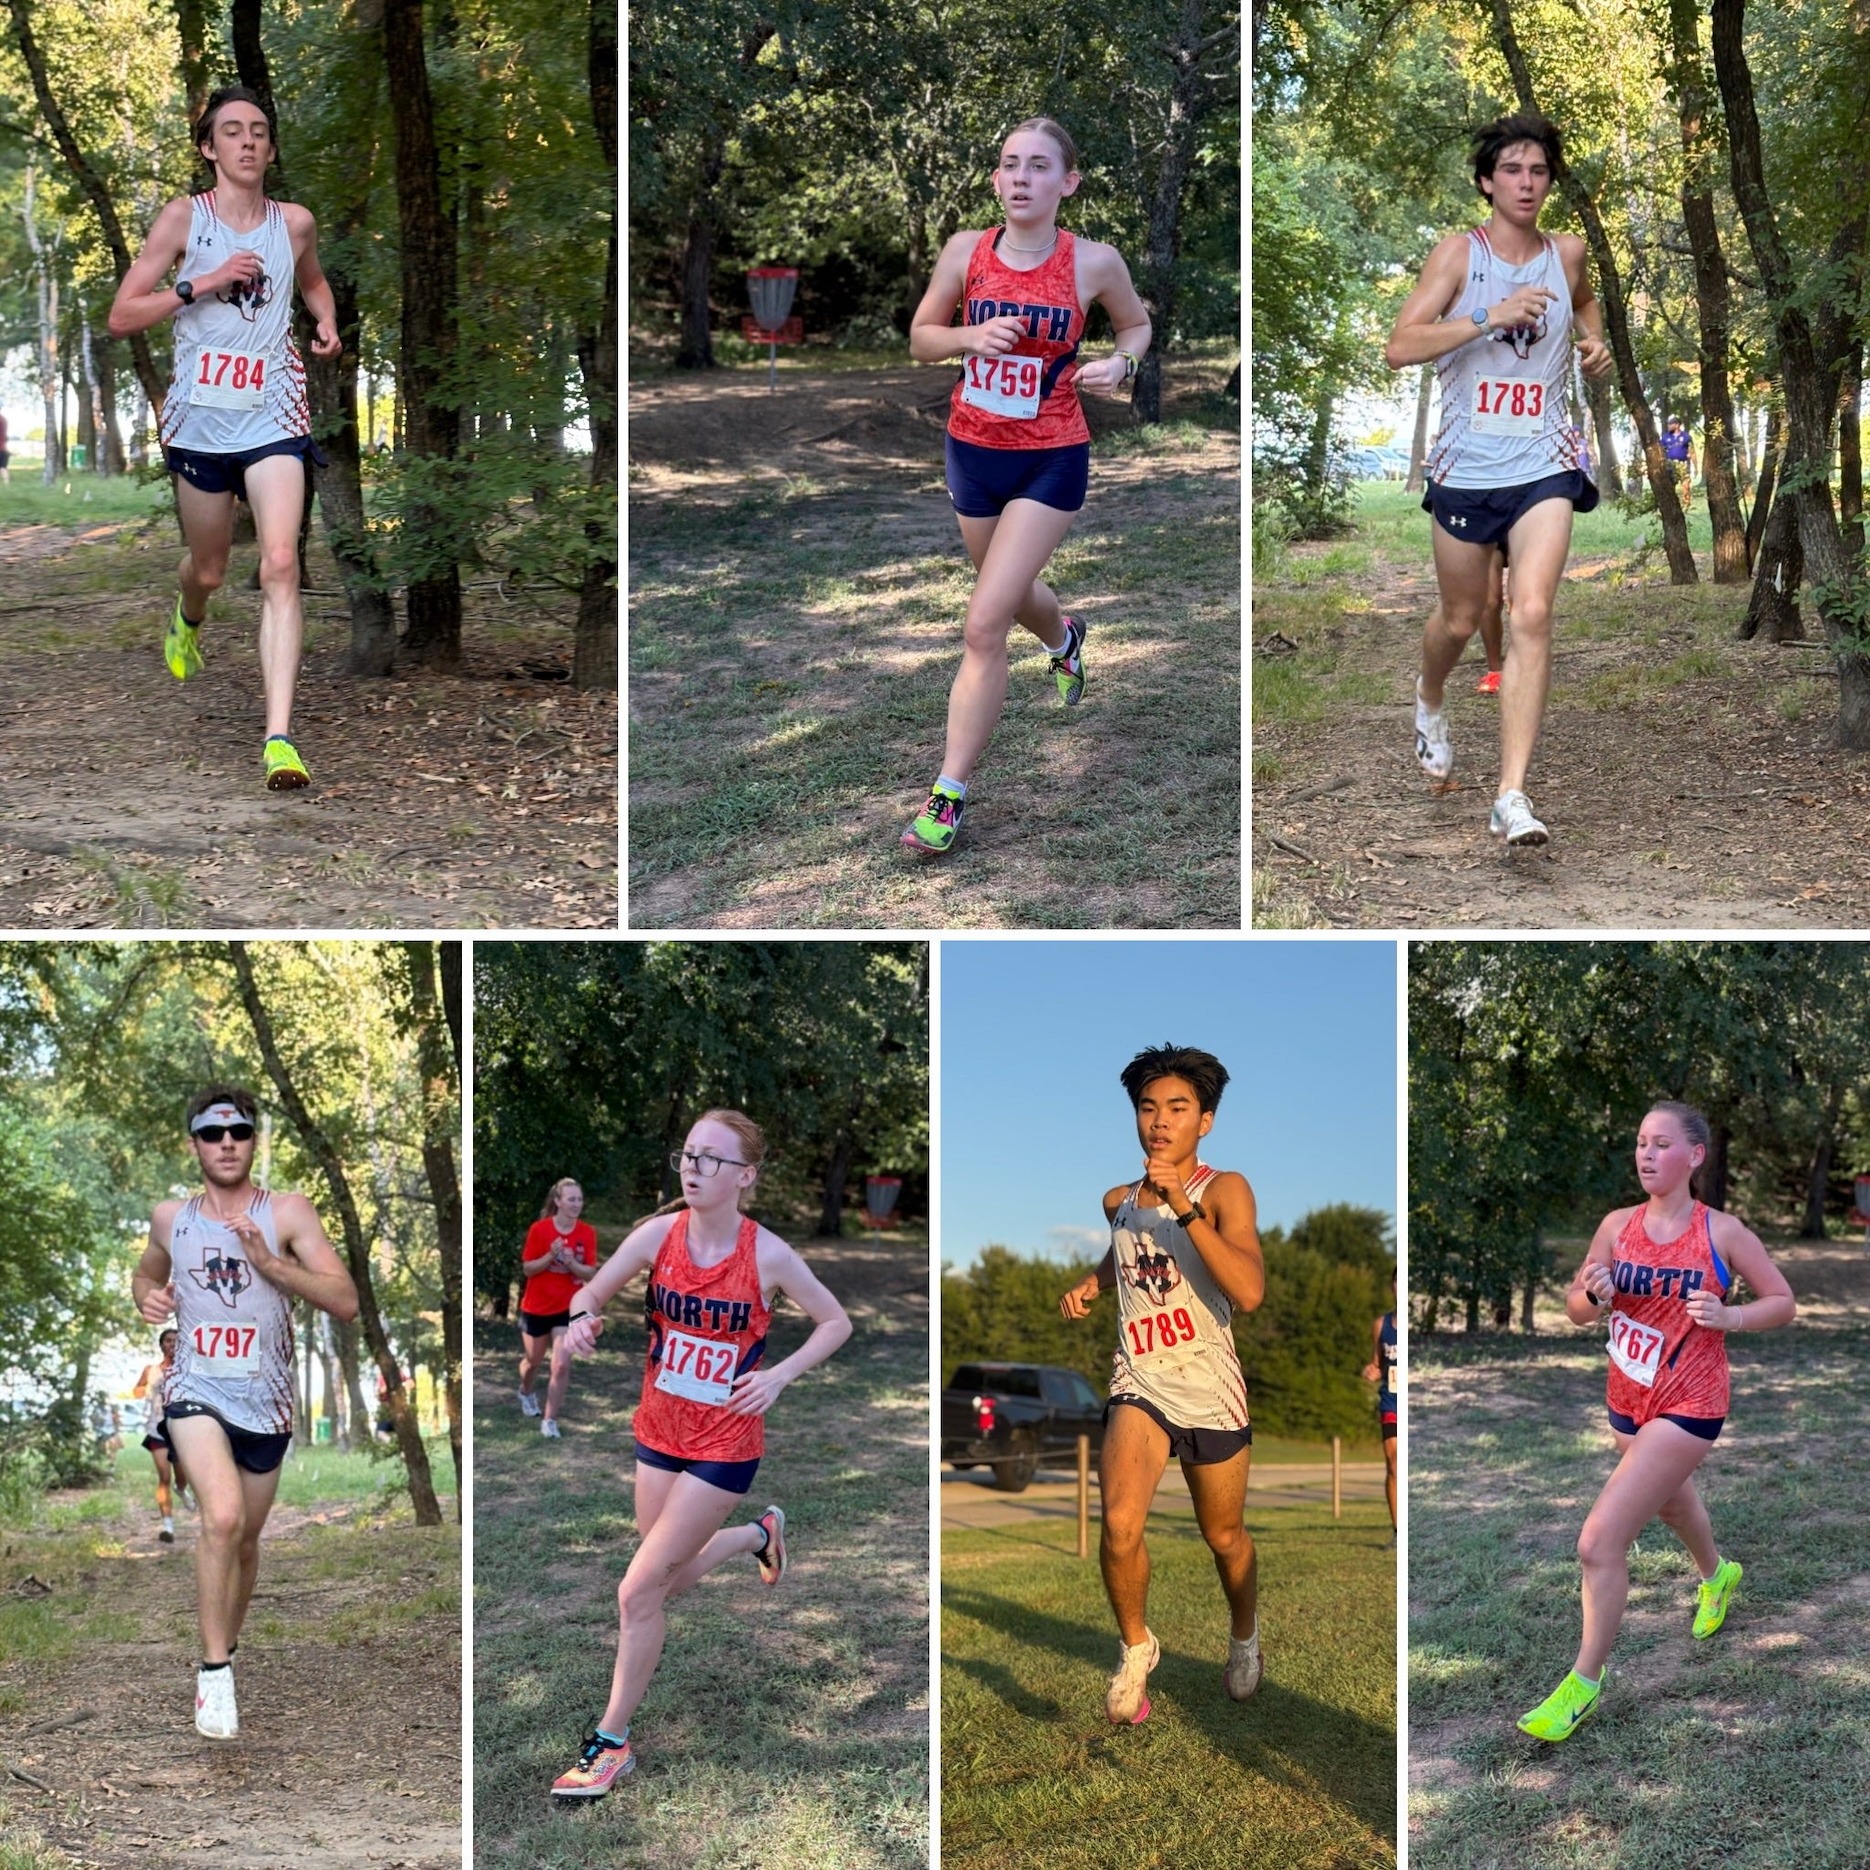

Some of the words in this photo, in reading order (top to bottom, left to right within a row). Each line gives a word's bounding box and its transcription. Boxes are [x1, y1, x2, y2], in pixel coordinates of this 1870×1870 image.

[197, 351, 265, 391] 1784
[967, 355, 1038, 398] 1759
[1477, 381, 1543, 417] 1783
[194, 1327, 256, 1358] 1797
[1128, 1308, 1195, 1356] 1789
[665, 1337, 734, 1385] 1762
